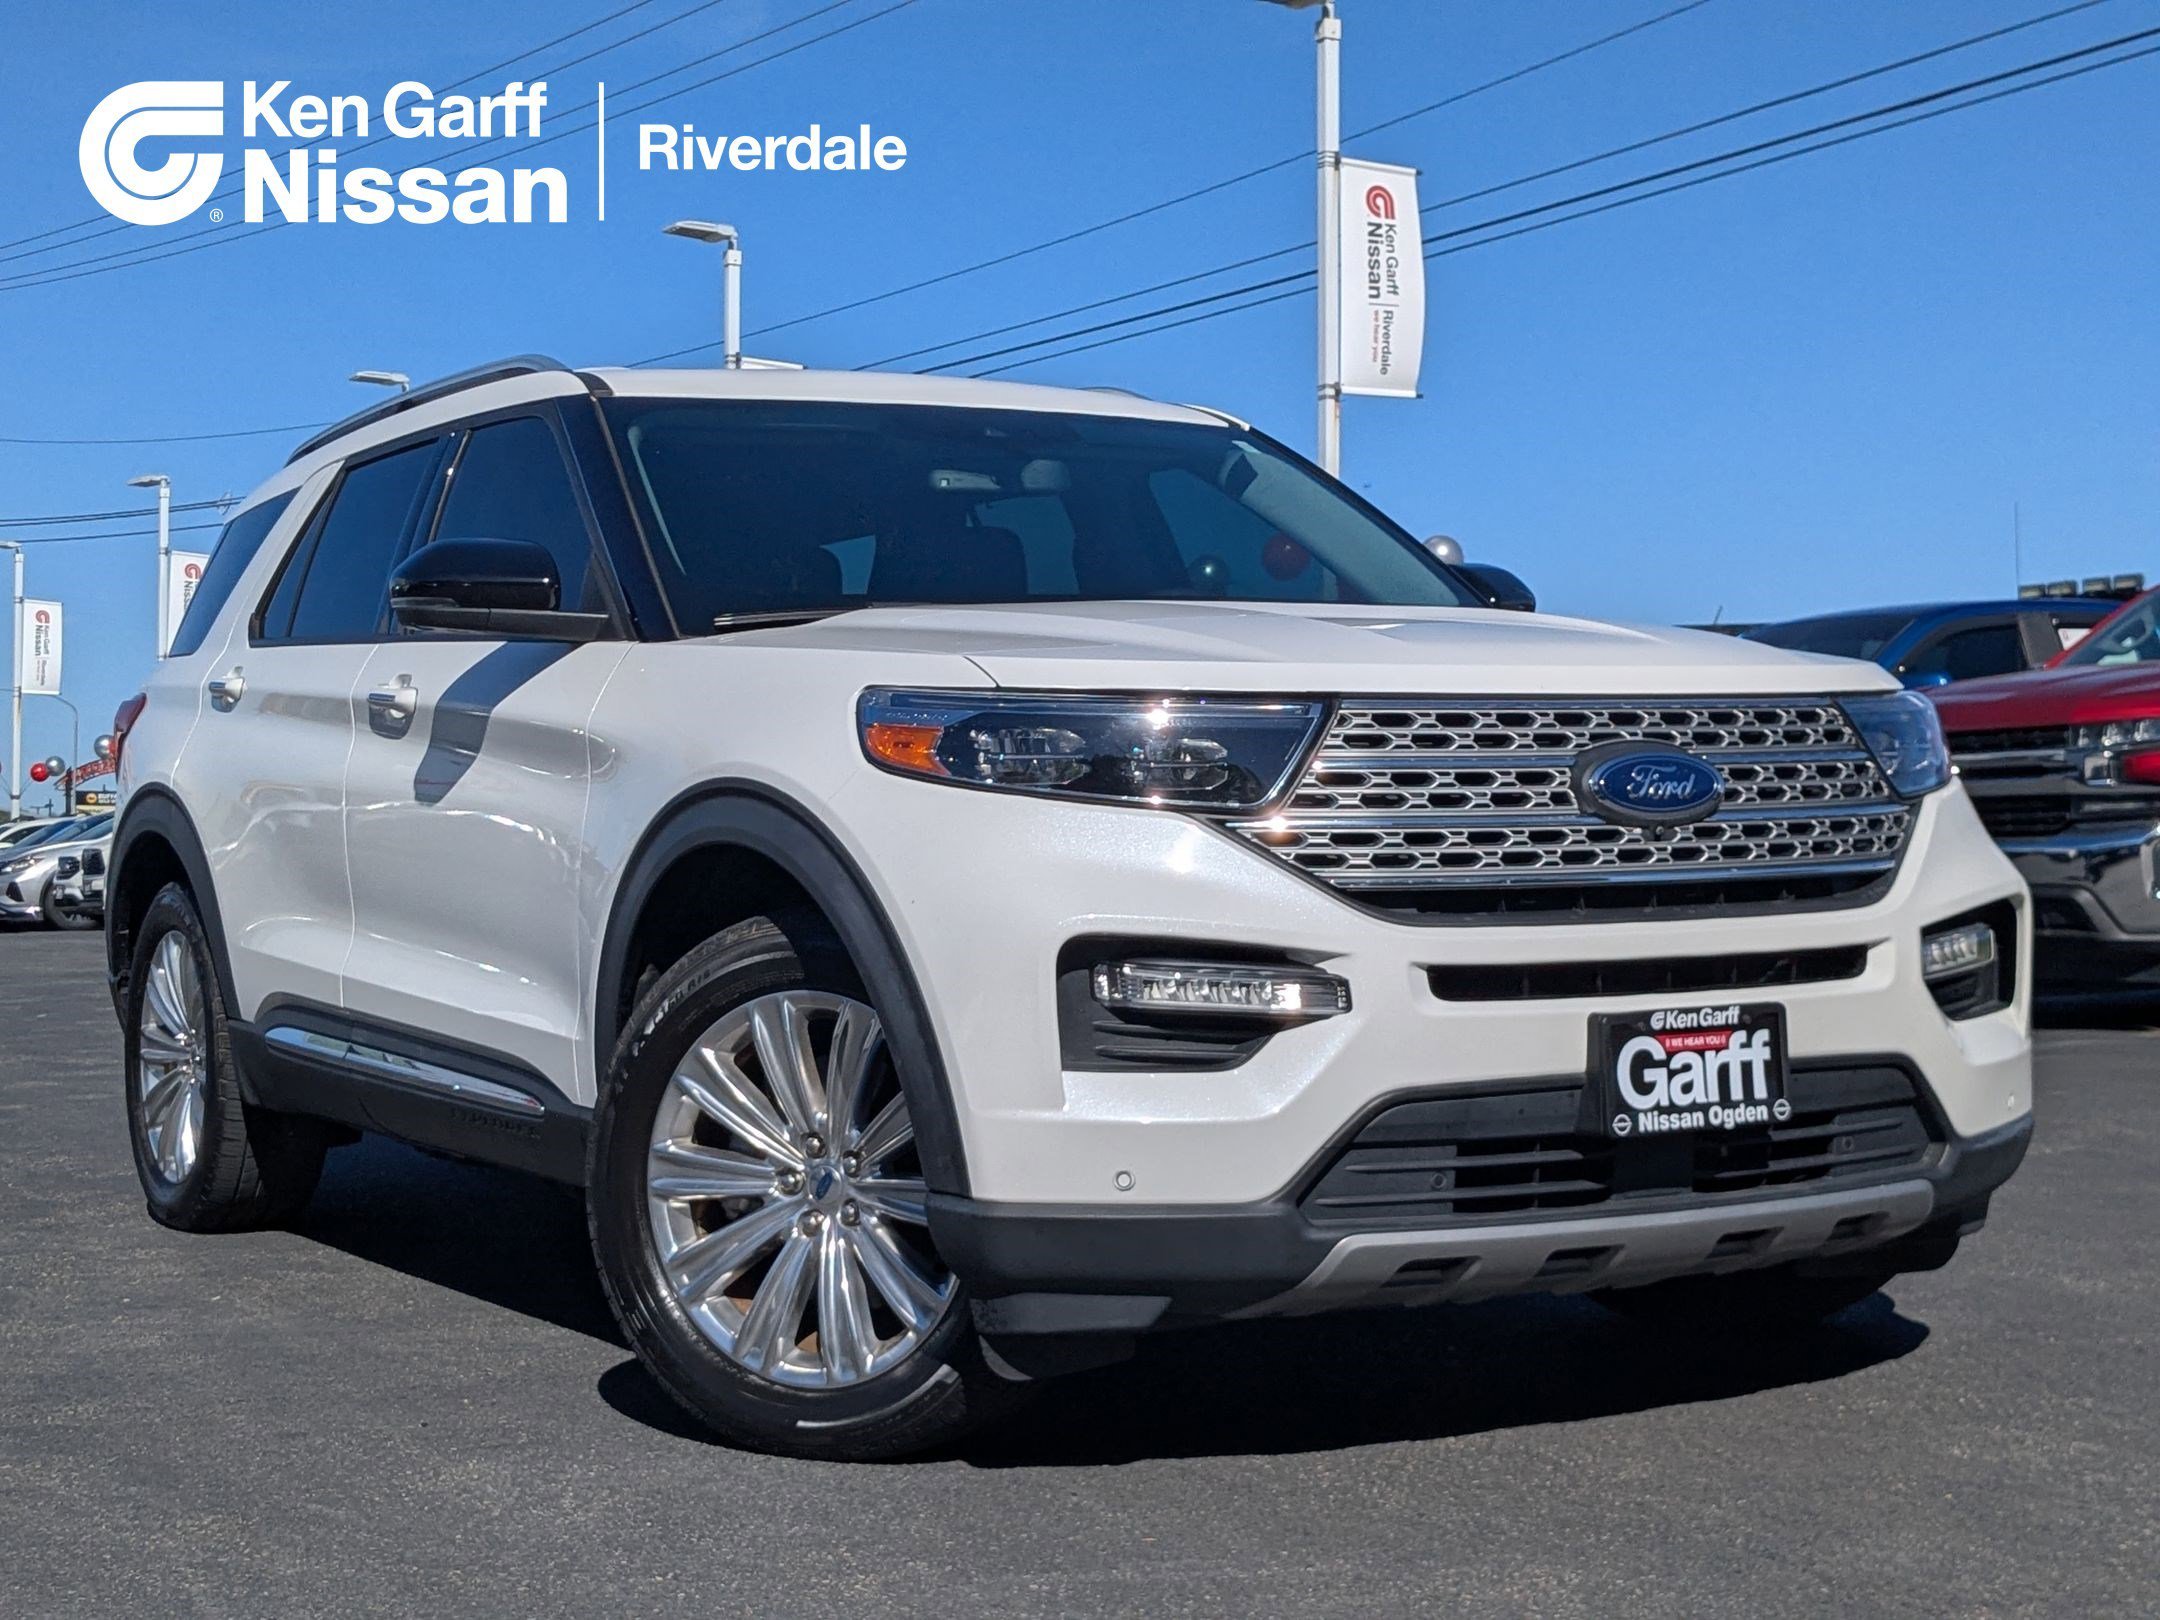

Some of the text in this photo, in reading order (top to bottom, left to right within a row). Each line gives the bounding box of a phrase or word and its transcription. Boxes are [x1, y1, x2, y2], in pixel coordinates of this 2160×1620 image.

[1367, 221, 1384, 299] Nissan
[1384, 223, 1400, 296] Ken Garff
[1379, 310, 1394, 376] Riverdale
[35, 624, 43, 656] Nissan
[1627, 764, 1696, 800] Ford
[1665, 1005, 1741, 1030] Ken Garff
[1616, 1028, 1771, 1110] Garff
[1637, 1103, 1769, 1133] Nissan Ogden
